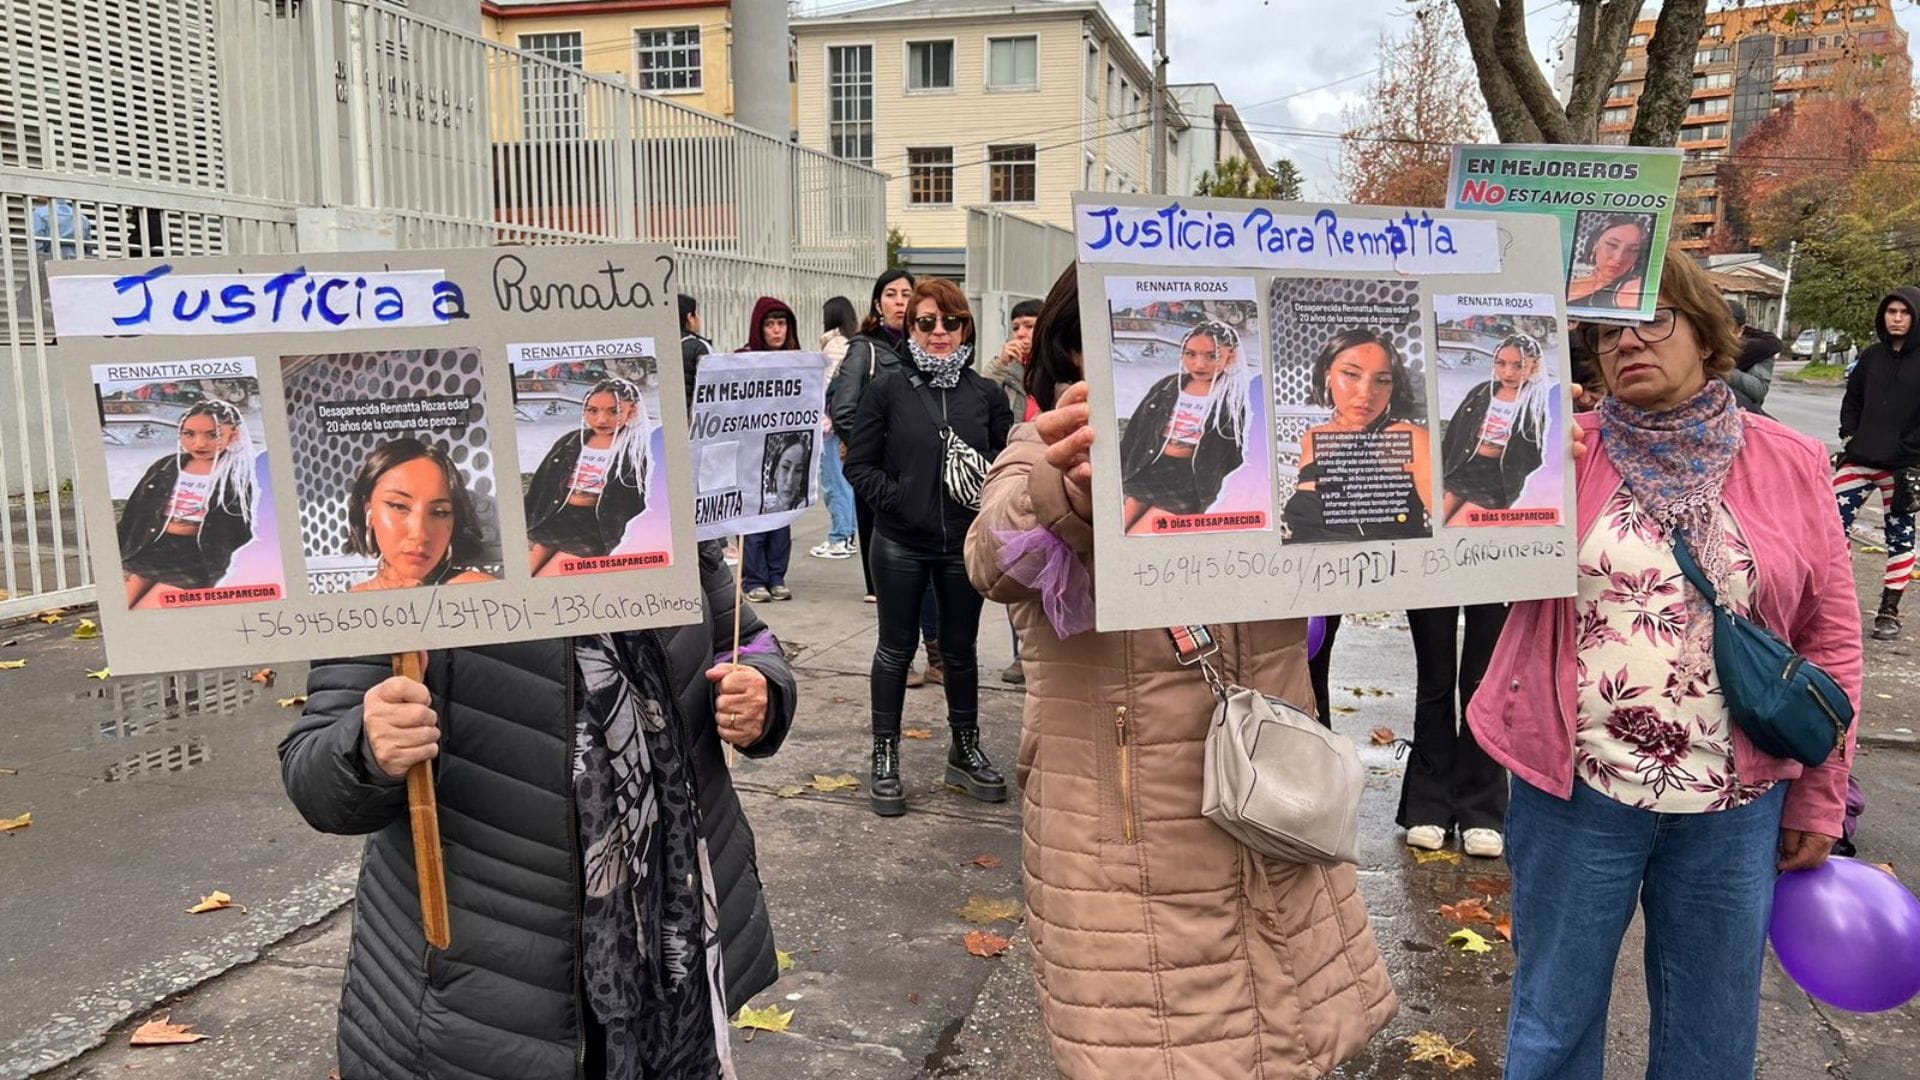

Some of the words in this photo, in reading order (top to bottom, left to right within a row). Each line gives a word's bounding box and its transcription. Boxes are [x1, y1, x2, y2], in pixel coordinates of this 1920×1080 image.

[1467, 158, 1495, 175] EN
[1501, 159, 1638, 180] MEJOREROS
[1508, 188, 1596, 206] ESTAMOS
[1603, 192, 1668, 209] TODOS
[432, 280, 471, 321] a
[493, 253, 675, 313] Renata?
[1136, 281, 1192, 293] RENNATTA
[1194, 281, 1228, 293] ROZAS
[1457, 295, 1503, 308] RENNATTA
[1505, 297, 1534, 309] ROZAS
[521, 344, 594, 359] RENNATTA
[597, 342, 643, 355] ROZAS
[108, 364, 188, 380] RENNATTA
[191, 362, 242, 376] ROZAS
[696, 384, 716, 403] EN
[719, 379, 802, 401] MEJOREROS
[318, 403, 380, 418] Desaparecida
[380, 402, 420, 413] Rennatta
[421, 400, 447, 411] Rozas
[447, 398, 469, 410] edad
[326, 420, 338, 433] 20
[340, 420, 360, 432] años
[362, 419, 372, 430] de
[373, 418, 382, 430] la
[383, 419, 416, 429] comuna
[417, 416, 428, 428] de
[430, 416, 457, 428] penco
[722, 413, 777, 433] ESTAMOS
[779, 409, 819, 427] TODOS
[696, 490, 743, 525] ENNATTA
[1170, 518, 1192, 528] DÍAS
[1194, 515, 1261, 528] DESAPARECIDA
[1481, 512, 1499, 522] DÍAS
[1500, 511, 1555, 522] DESAPARECIDA
[564, 562, 574, 572] 13
[576, 558, 598, 570] DÍAS
[600, 555, 664, 568] DESAPARECIDA
[165, 595, 174, 604] 13
[176, 590, 202, 603] DÍAS
[204, 588, 276, 602] DESAPARECIDA
